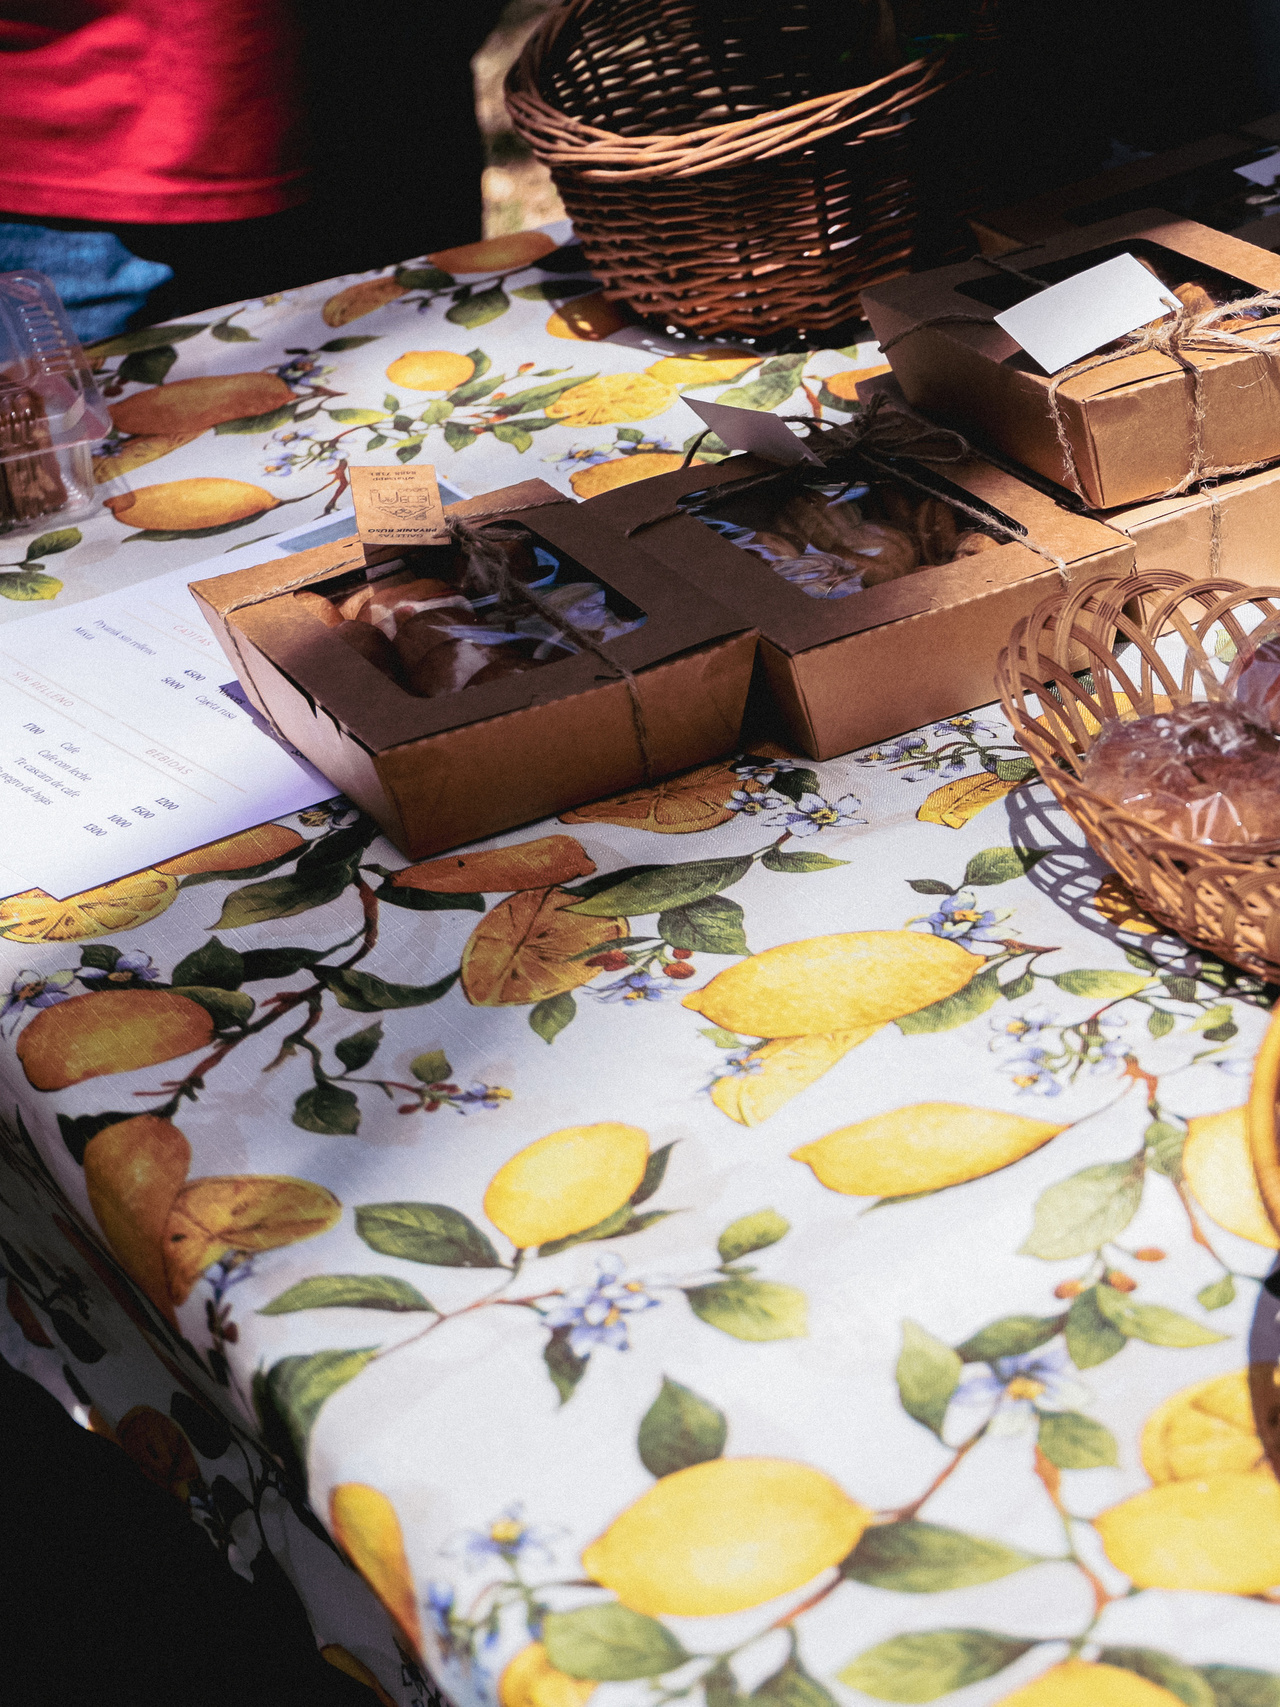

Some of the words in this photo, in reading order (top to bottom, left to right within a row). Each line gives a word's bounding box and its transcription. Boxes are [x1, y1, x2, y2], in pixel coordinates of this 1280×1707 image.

[73, 626, 95, 641] Mixta
[173, 624, 214, 648] CAJITAS
[119, 633, 131, 643] sin
[129, 640, 157, 656] relleno
[12, 670, 31, 683] SIN
[29, 678, 75, 707] RELLENO
[161, 676, 186, 690] 5000
[195, 694, 220, 713] Cajeta
[218, 705, 238, 720] rusa
[22, 722, 46, 735] 1700
[145, 748, 194, 776] BEBIDAS
[54, 759, 72, 772] con
[68, 767, 92, 783] leche
[21, 785, 34, 794] de
[51, 778, 65, 789] de
[154, 797, 180, 811] 1200
[130, 805, 156, 819] 1500
[107, 814, 133, 828] 1000
[83, 823, 108, 837] 1300
